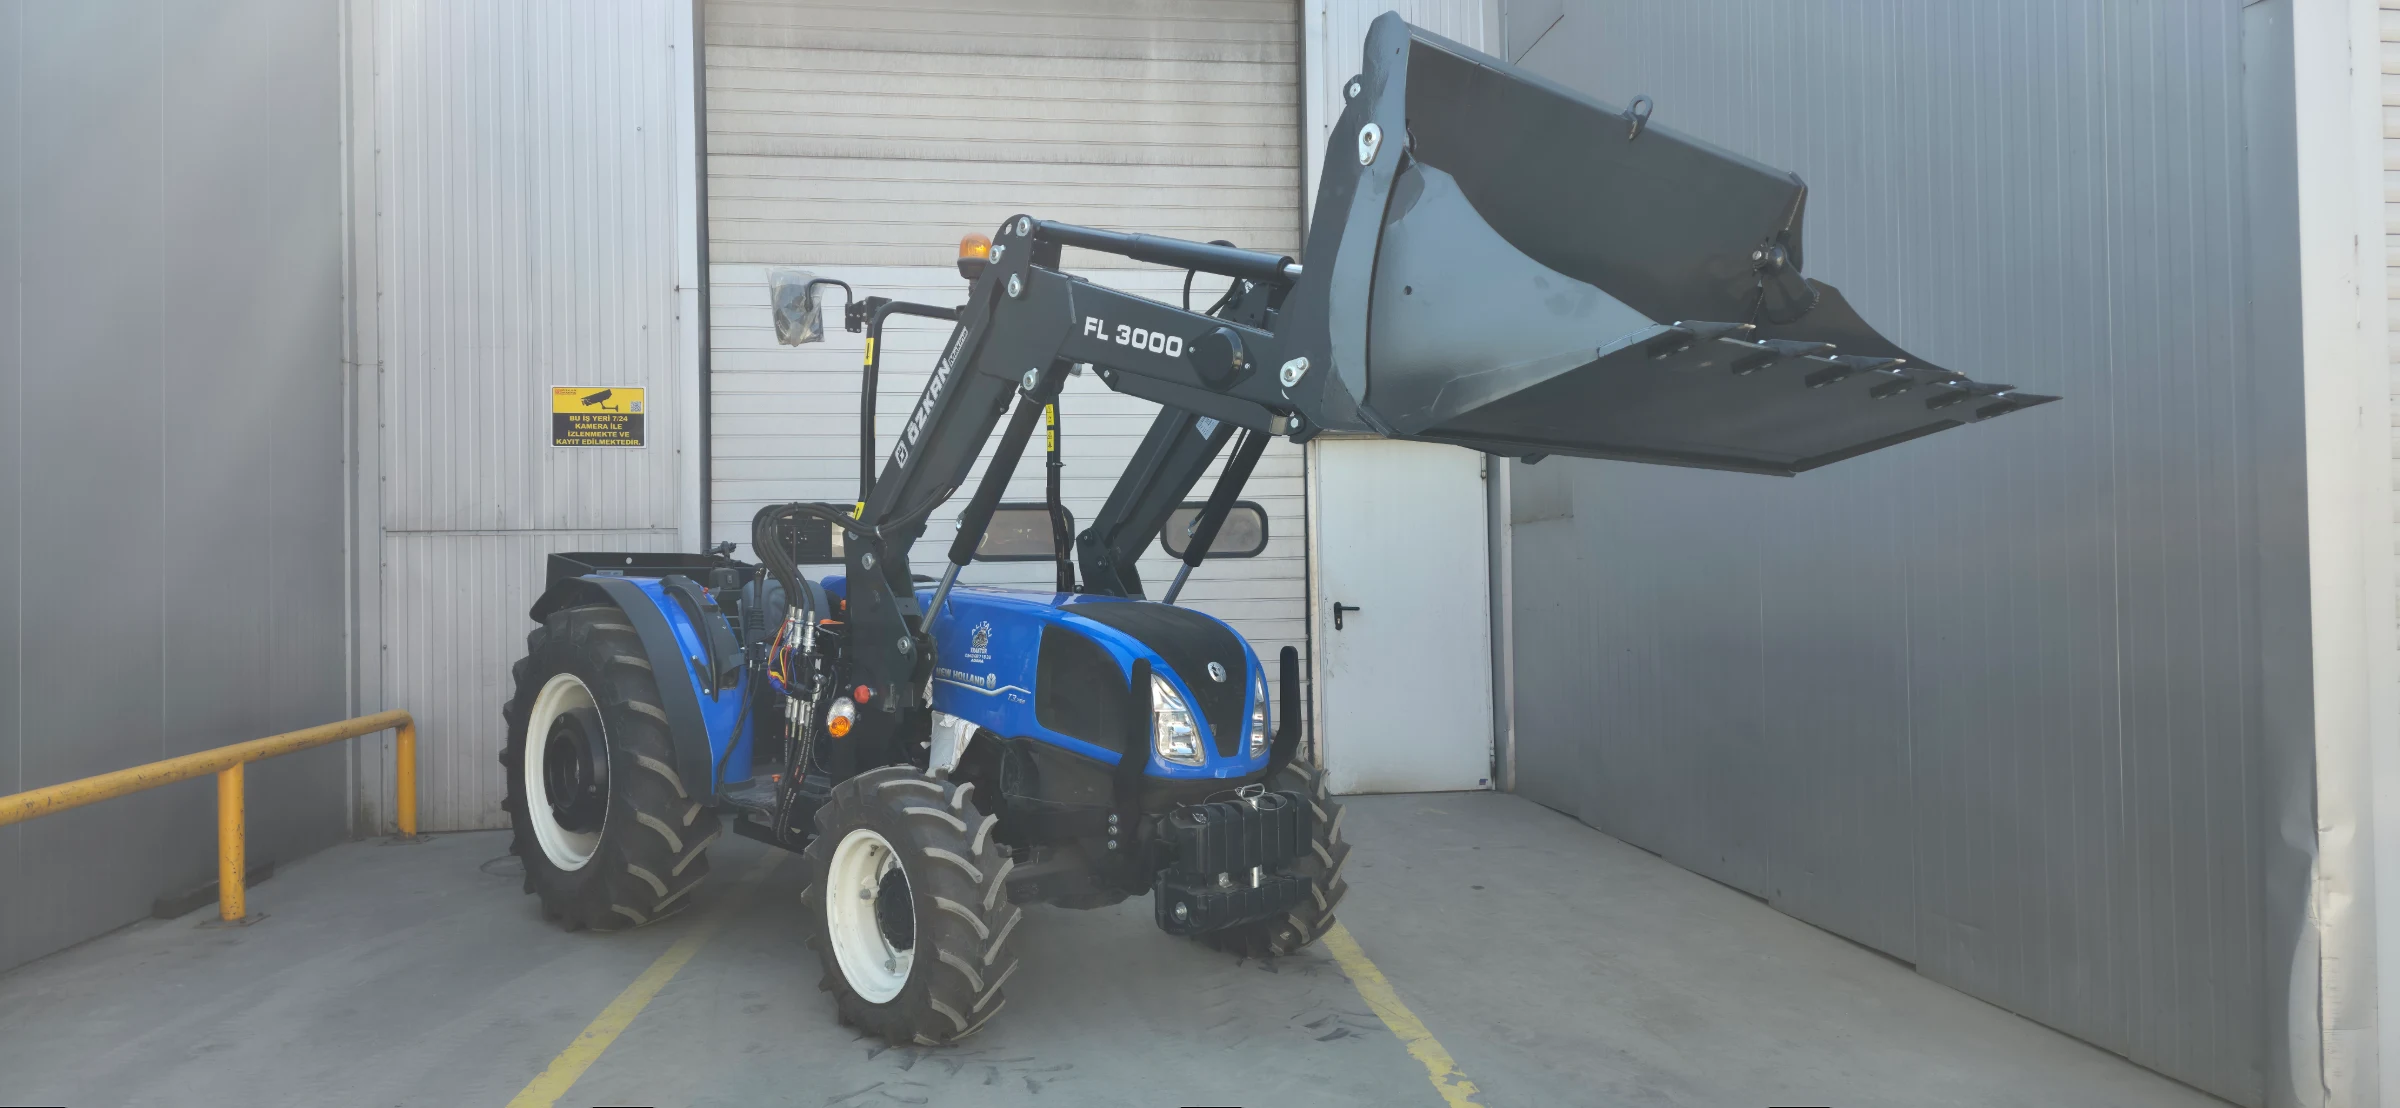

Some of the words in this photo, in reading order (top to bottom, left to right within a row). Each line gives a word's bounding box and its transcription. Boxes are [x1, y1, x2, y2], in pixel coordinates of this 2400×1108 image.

[1083, 315, 1109, 341] FL
[1115, 324, 1184, 358] 3000
[907, 357, 951, 446] ÖZKAN
[582, 414, 590, 422] İŞ
[592, 414, 611, 422] YERİ
[610, 422, 623, 430] İLE
[581, 438, 641, 446] EDİLMEKTEDİR.
[936, 666, 952, 678] NEW
[952, 669, 985, 687] HOLLAND
